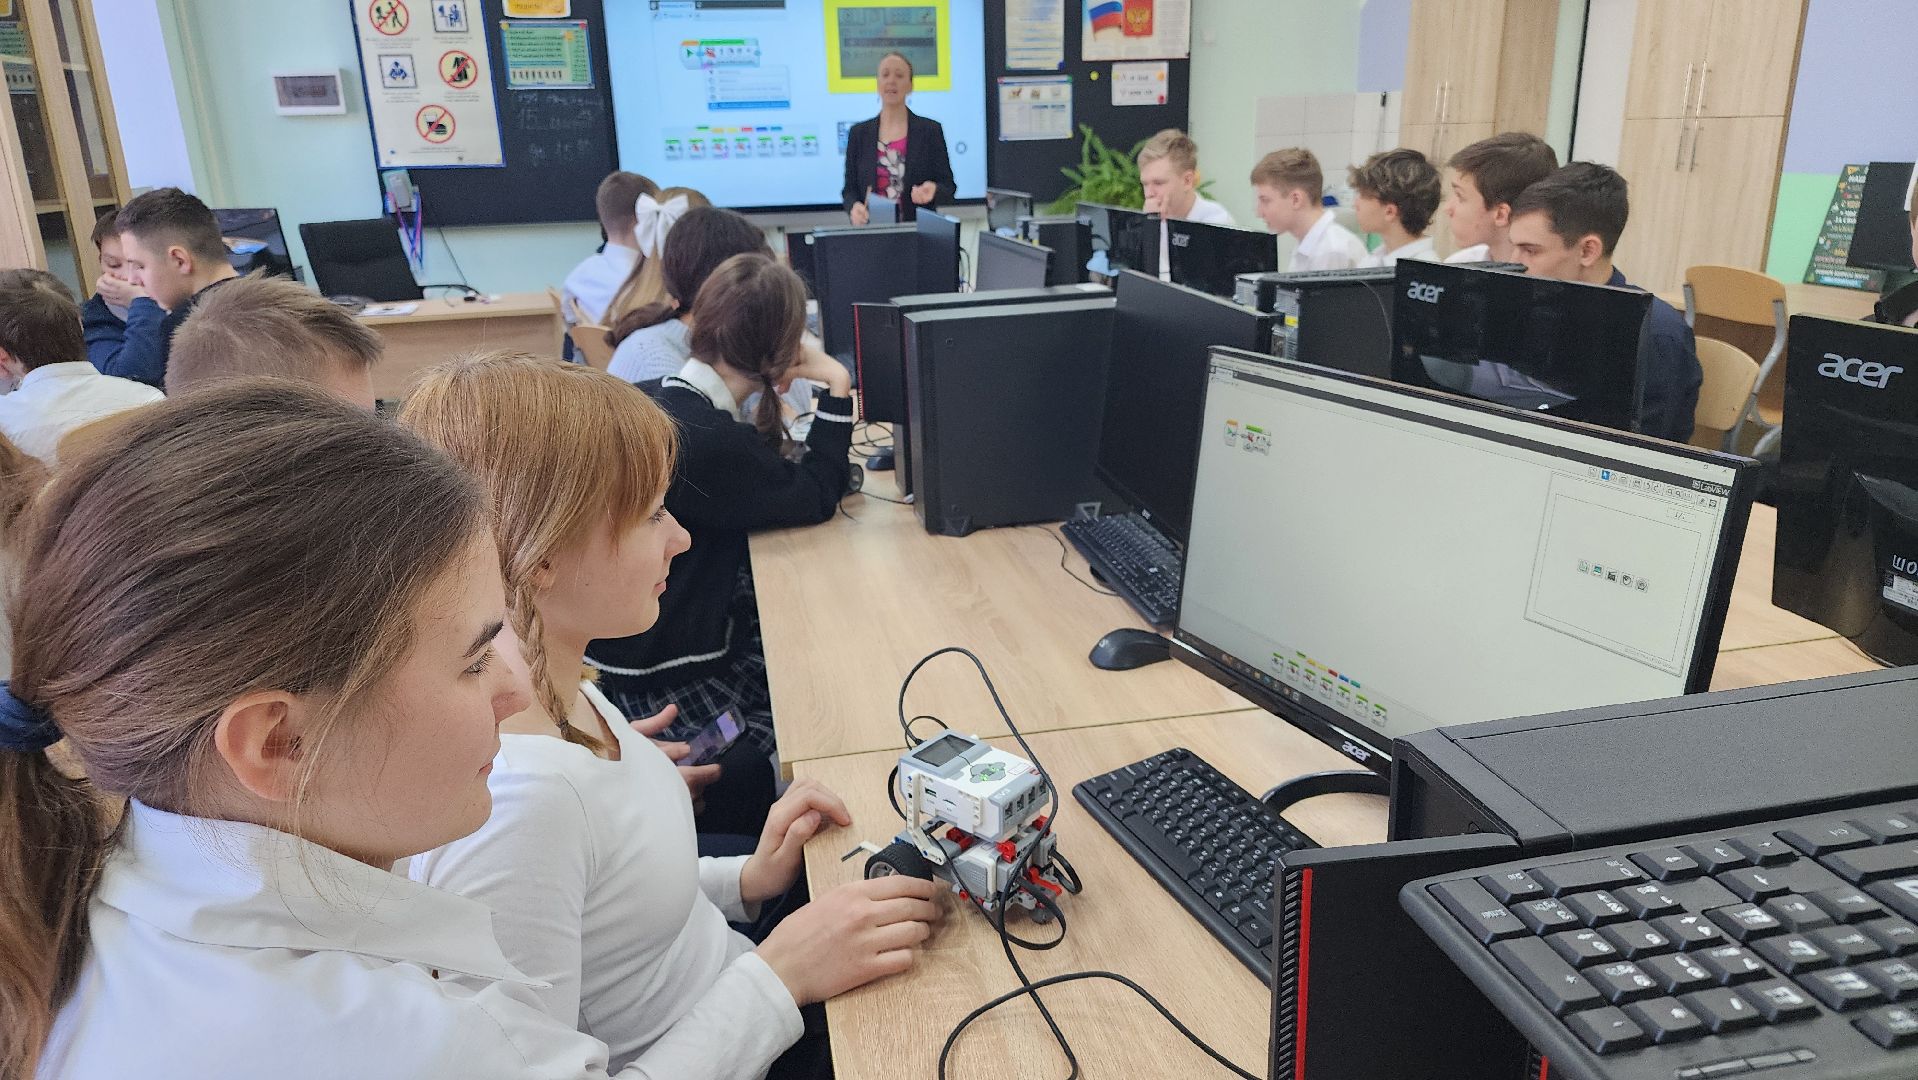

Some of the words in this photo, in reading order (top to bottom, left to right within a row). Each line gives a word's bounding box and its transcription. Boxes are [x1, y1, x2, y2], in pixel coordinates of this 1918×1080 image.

[1171, 233, 1190, 247] acer
[1407, 281, 1445, 304] acer
[1817, 353, 1904, 389] acer
[1700, 482, 1731, 497] LabVIEW
[1342, 740, 1371, 761] acer
